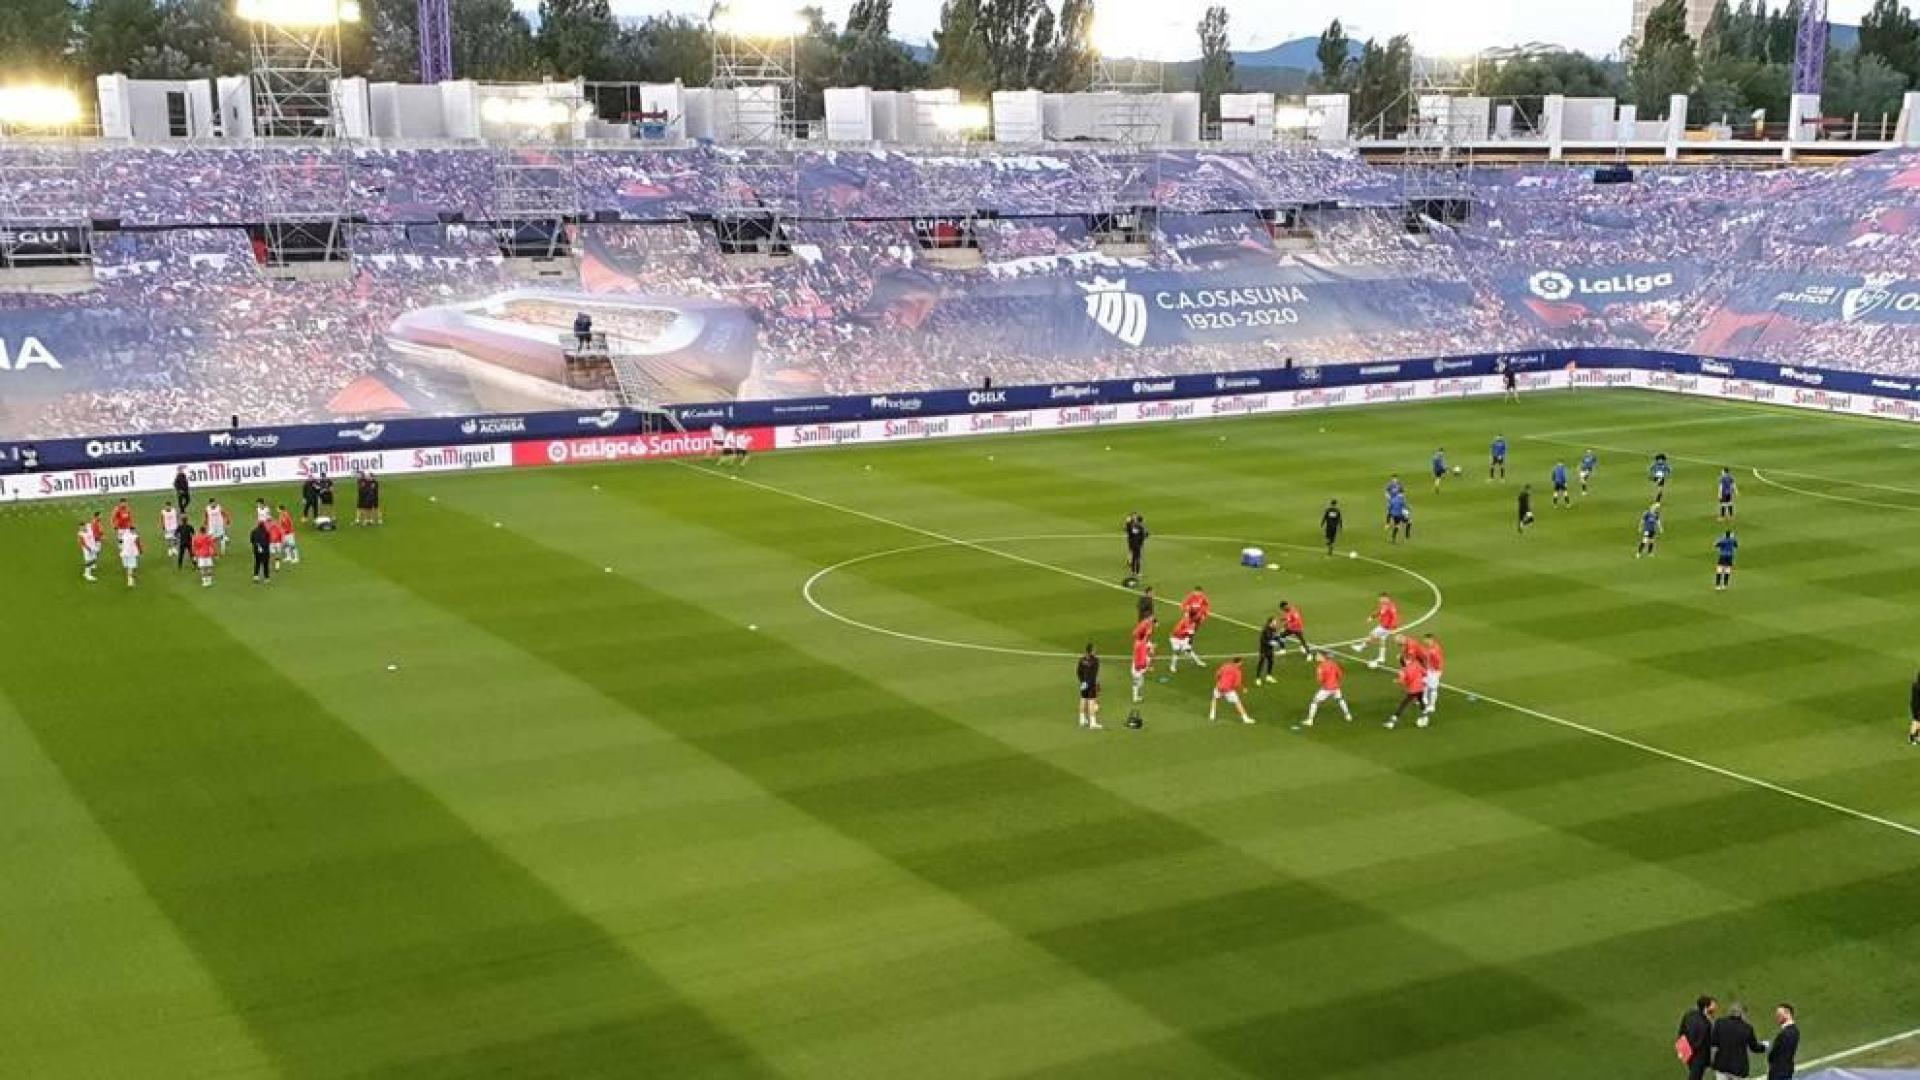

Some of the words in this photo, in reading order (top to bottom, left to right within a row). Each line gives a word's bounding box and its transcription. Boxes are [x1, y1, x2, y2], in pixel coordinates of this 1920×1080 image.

[1579, 272, 1673, 293] LaLiga
[1156, 286, 1309, 309] C.A.OSASUNA
[1182, 308, 1299, 330] 1920-2020
